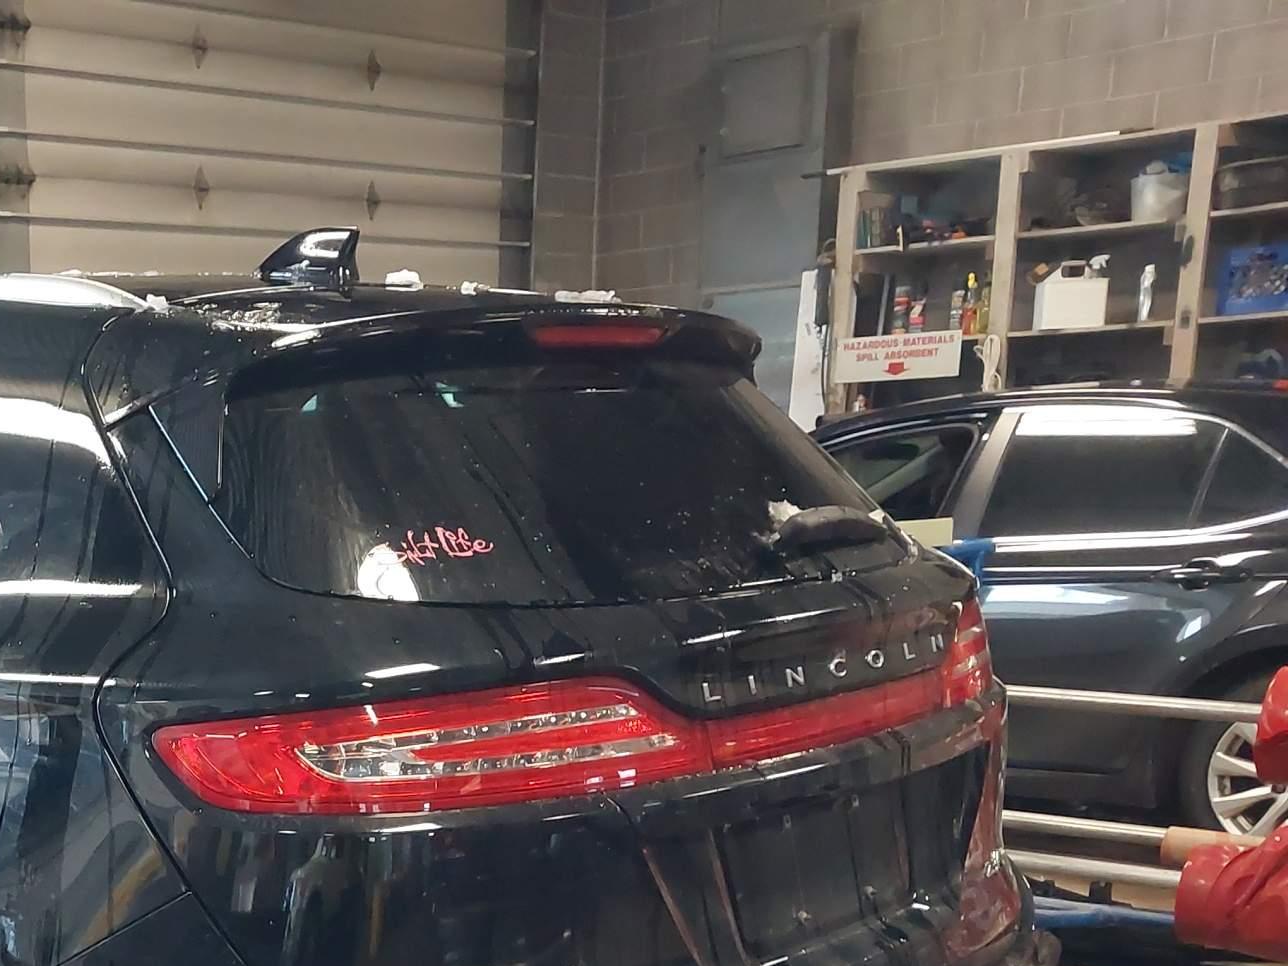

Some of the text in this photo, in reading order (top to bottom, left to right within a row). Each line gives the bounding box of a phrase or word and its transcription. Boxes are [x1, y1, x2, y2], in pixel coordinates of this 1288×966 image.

[843, 334, 955, 352] HAZARDOUS MATERIALS
[855, 347, 939, 362] SPILL ABSORBENT
[701, 633, 944, 703] LINCOLN
